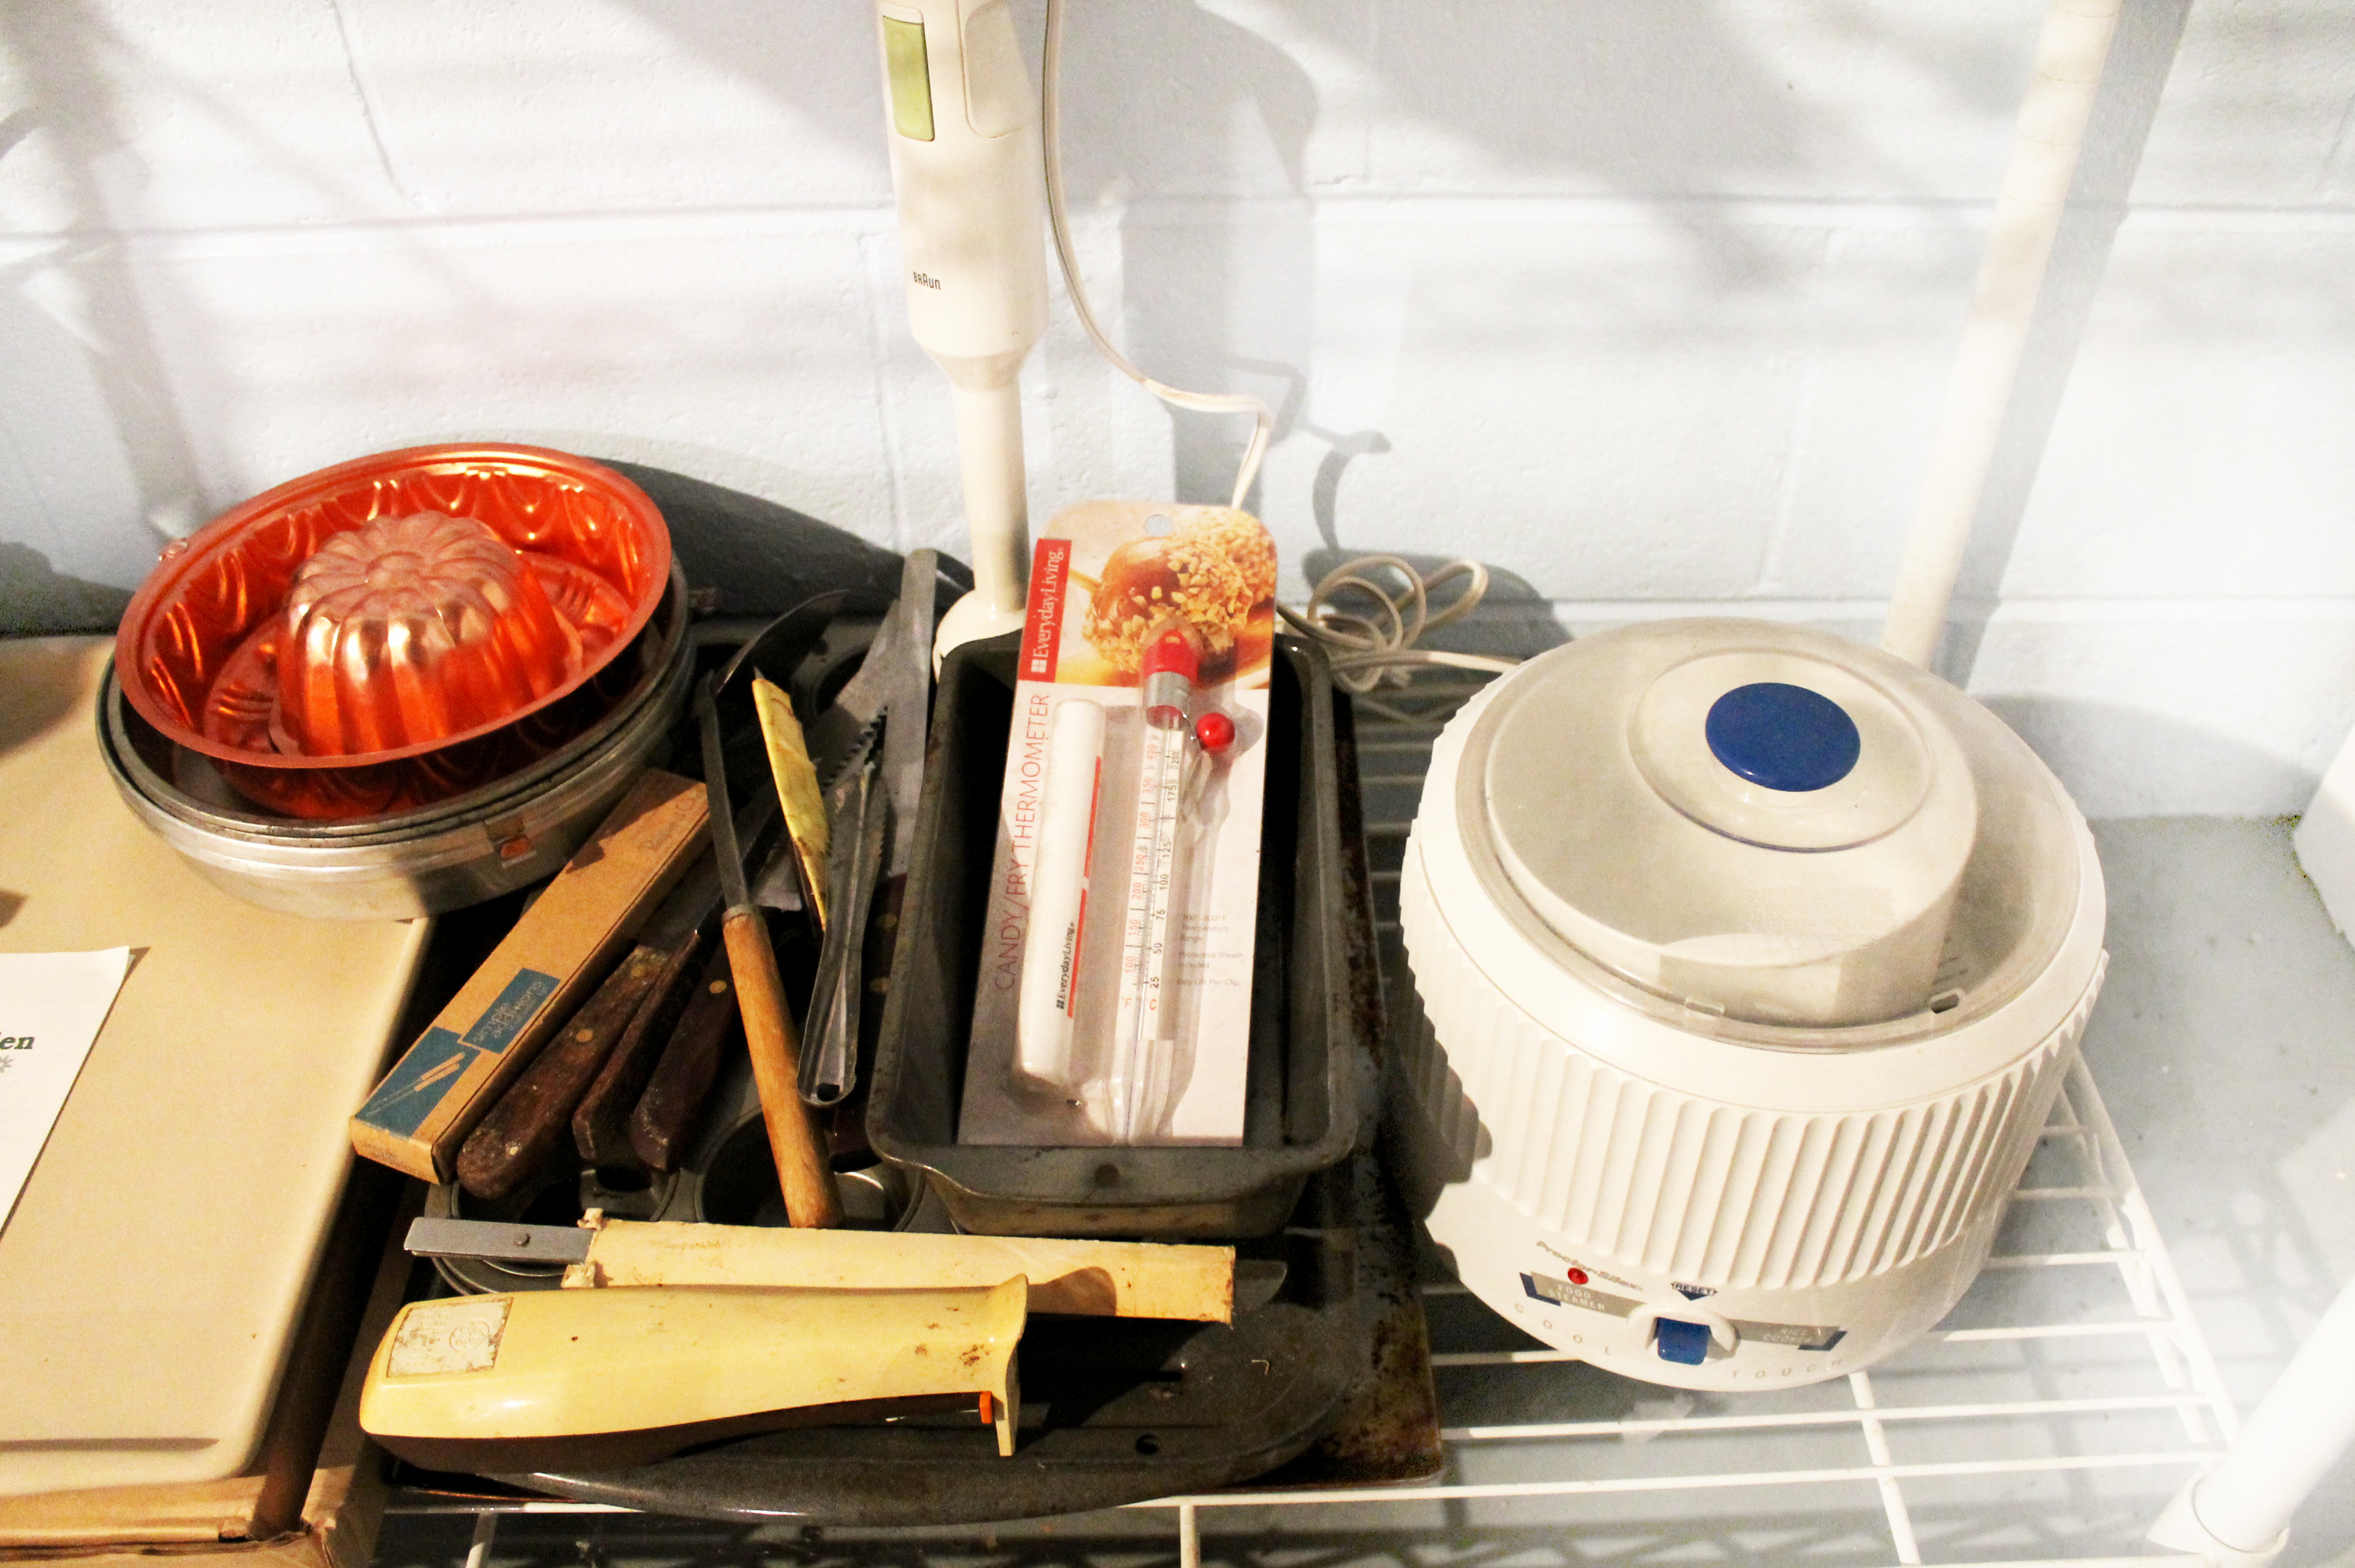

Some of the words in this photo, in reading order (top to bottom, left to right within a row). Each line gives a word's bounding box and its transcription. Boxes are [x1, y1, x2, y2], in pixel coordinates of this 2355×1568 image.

[1013, 693, 1050, 853] THERMOMETER
[1131, 882, 1142, 900] 200
[1159, 874, 1169, 891] 100
[1156, 909, 1165, 921] 75
[1128, 919, 1139, 936] 150
[1153, 943, 1163, 955] 50
[1124, 956, 1135, 973] 100
[1150, 977, 1160, 989] 25
[0, 1032, 35, 1050] en
[1548, 1288, 1605, 1311] STEAMER
[1558, 1284, 1592, 1300] FOOD
